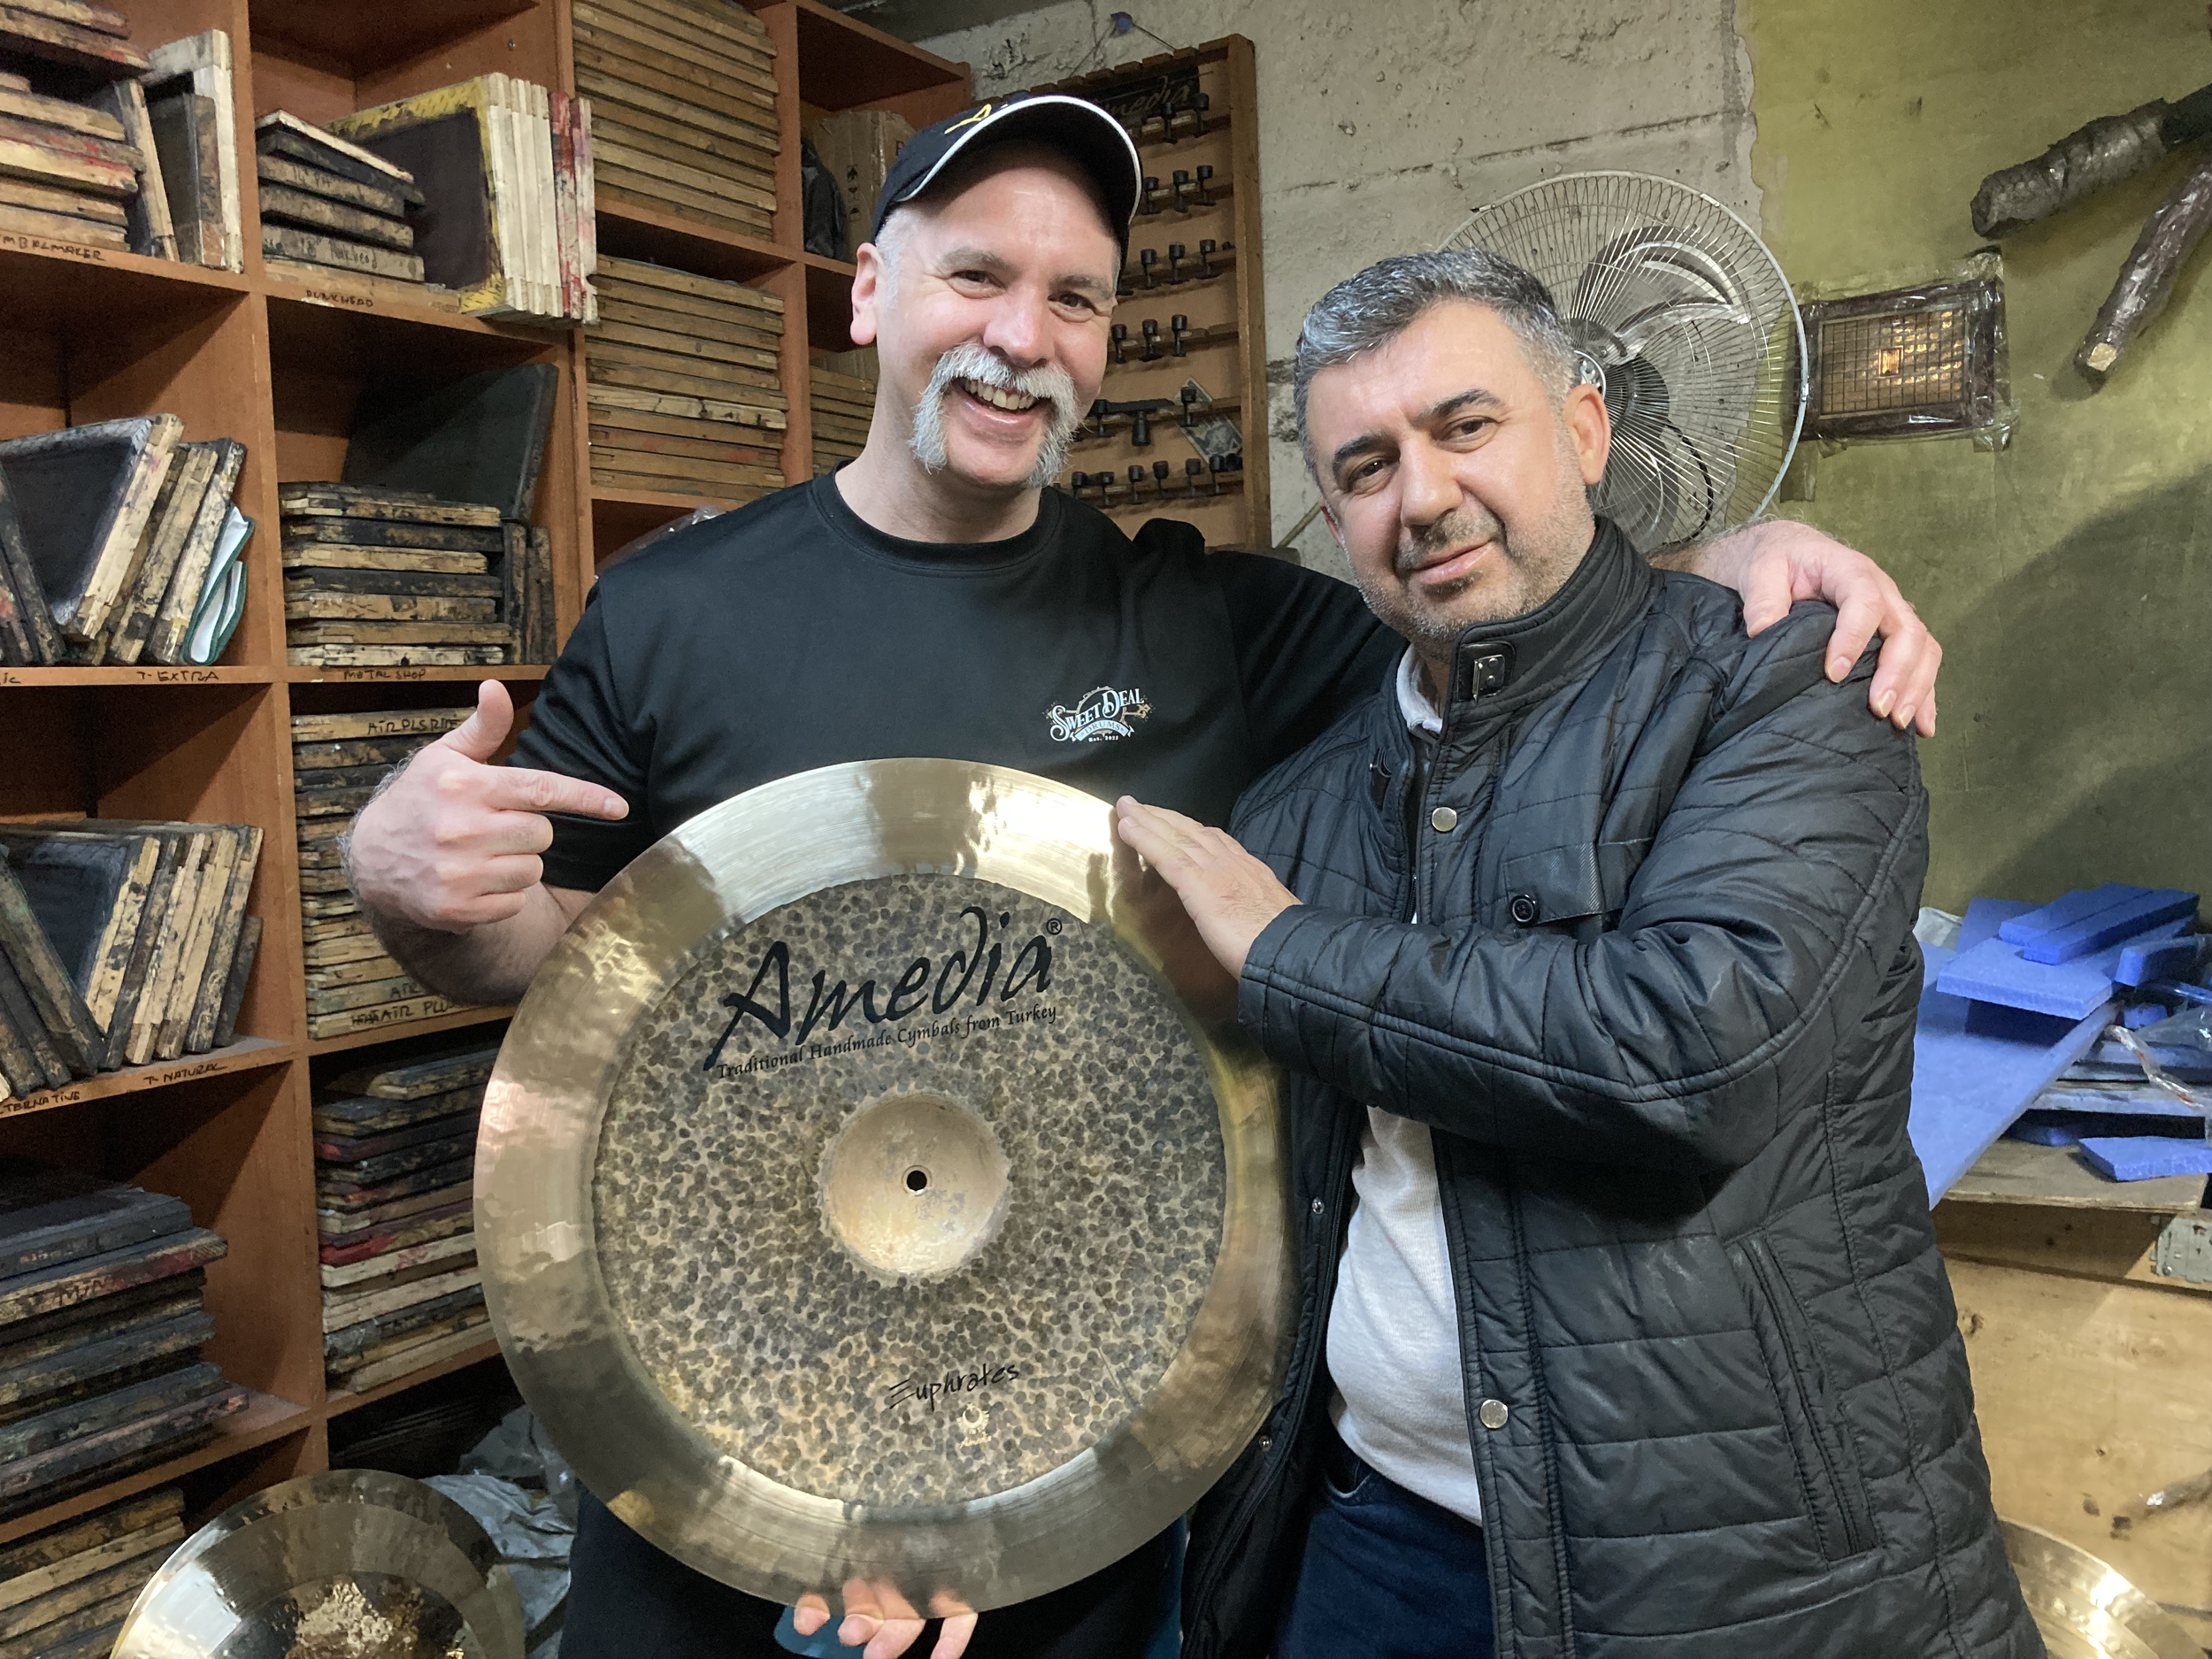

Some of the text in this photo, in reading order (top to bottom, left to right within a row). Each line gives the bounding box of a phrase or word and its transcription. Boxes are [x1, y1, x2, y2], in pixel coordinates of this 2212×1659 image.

[1049, 688, 1145, 741] SWEET DEAL
[1084, 720, 1121, 734] DRUMS
[717, 1003, 1056, 1079] Traditional Handmade Cymbals from Turkey
[888, 1363, 1020, 1412] Euphrates
